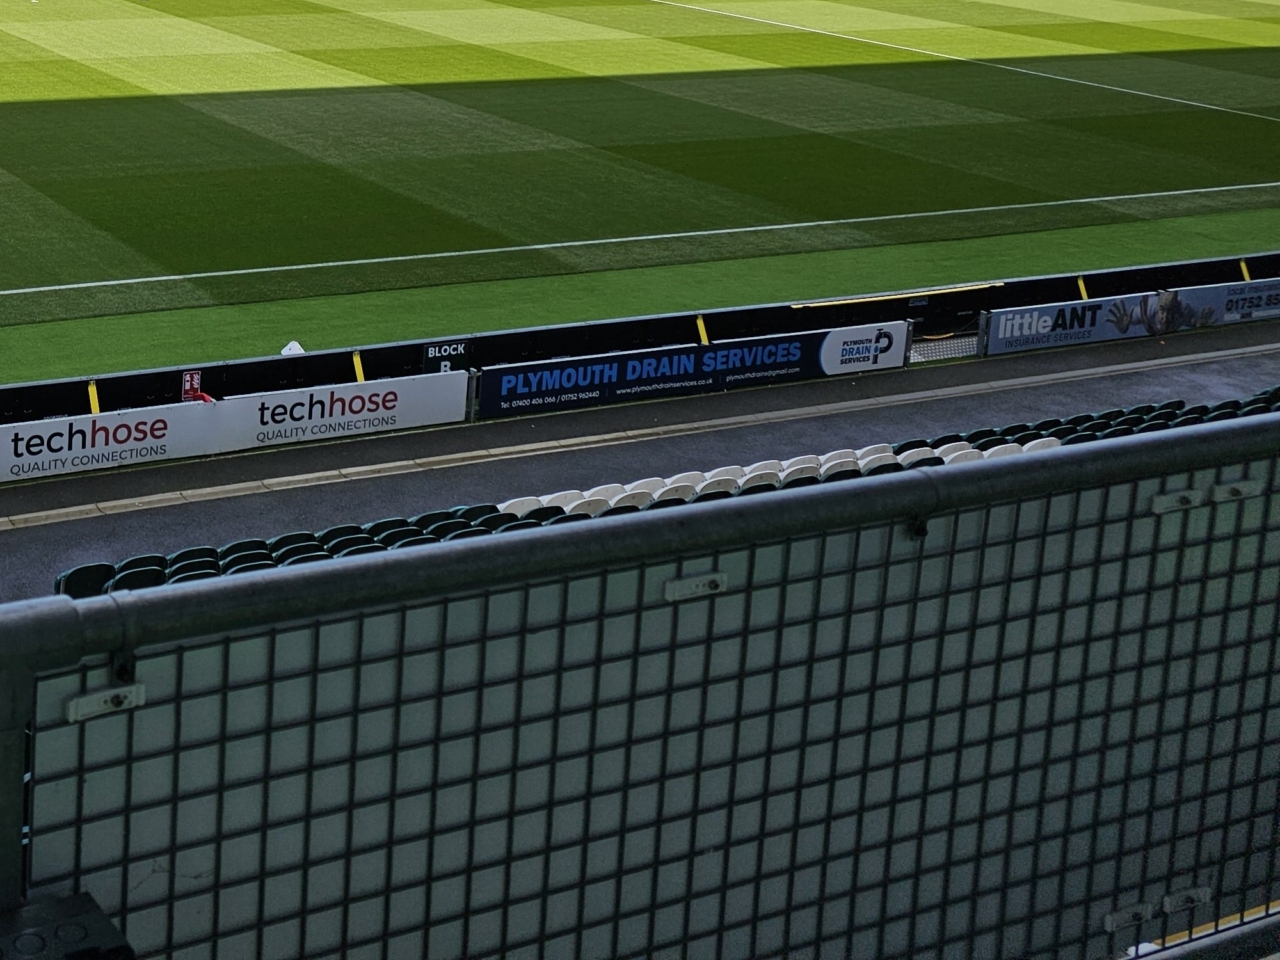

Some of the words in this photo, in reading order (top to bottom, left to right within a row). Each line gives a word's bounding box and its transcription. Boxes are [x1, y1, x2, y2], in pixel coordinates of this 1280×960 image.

[997, 303, 1103, 339] littleANT
[428, 343, 465, 358] BLOCK
[840, 345, 871, 358] DRAIN
[842, 338, 872, 348] PLYMOUTH
[1004, 335, 1052, 349] INSURANCE
[1053, 329, 1093, 343] SERVICES
[501, 364, 617, 396] PLYMOUTH
[625, 354, 695, 381] DRAIN
[701, 341, 801, 371] SERVICES
[839, 355, 870, 365] SERVICES
[561, 393, 578, 402] 01752
[616, 378, 713, 395] www.plymouthdrainservices.co.uk
[257, 390, 398, 426] techhose
[10, 418, 168, 459] techhose
[256, 425, 309, 441] QUALITY
[311, 414, 397, 437] CONNECTIONS
[10, 459, 69, 476] QUALITY
[70, 445, 167, 471] CONNECTIONS
